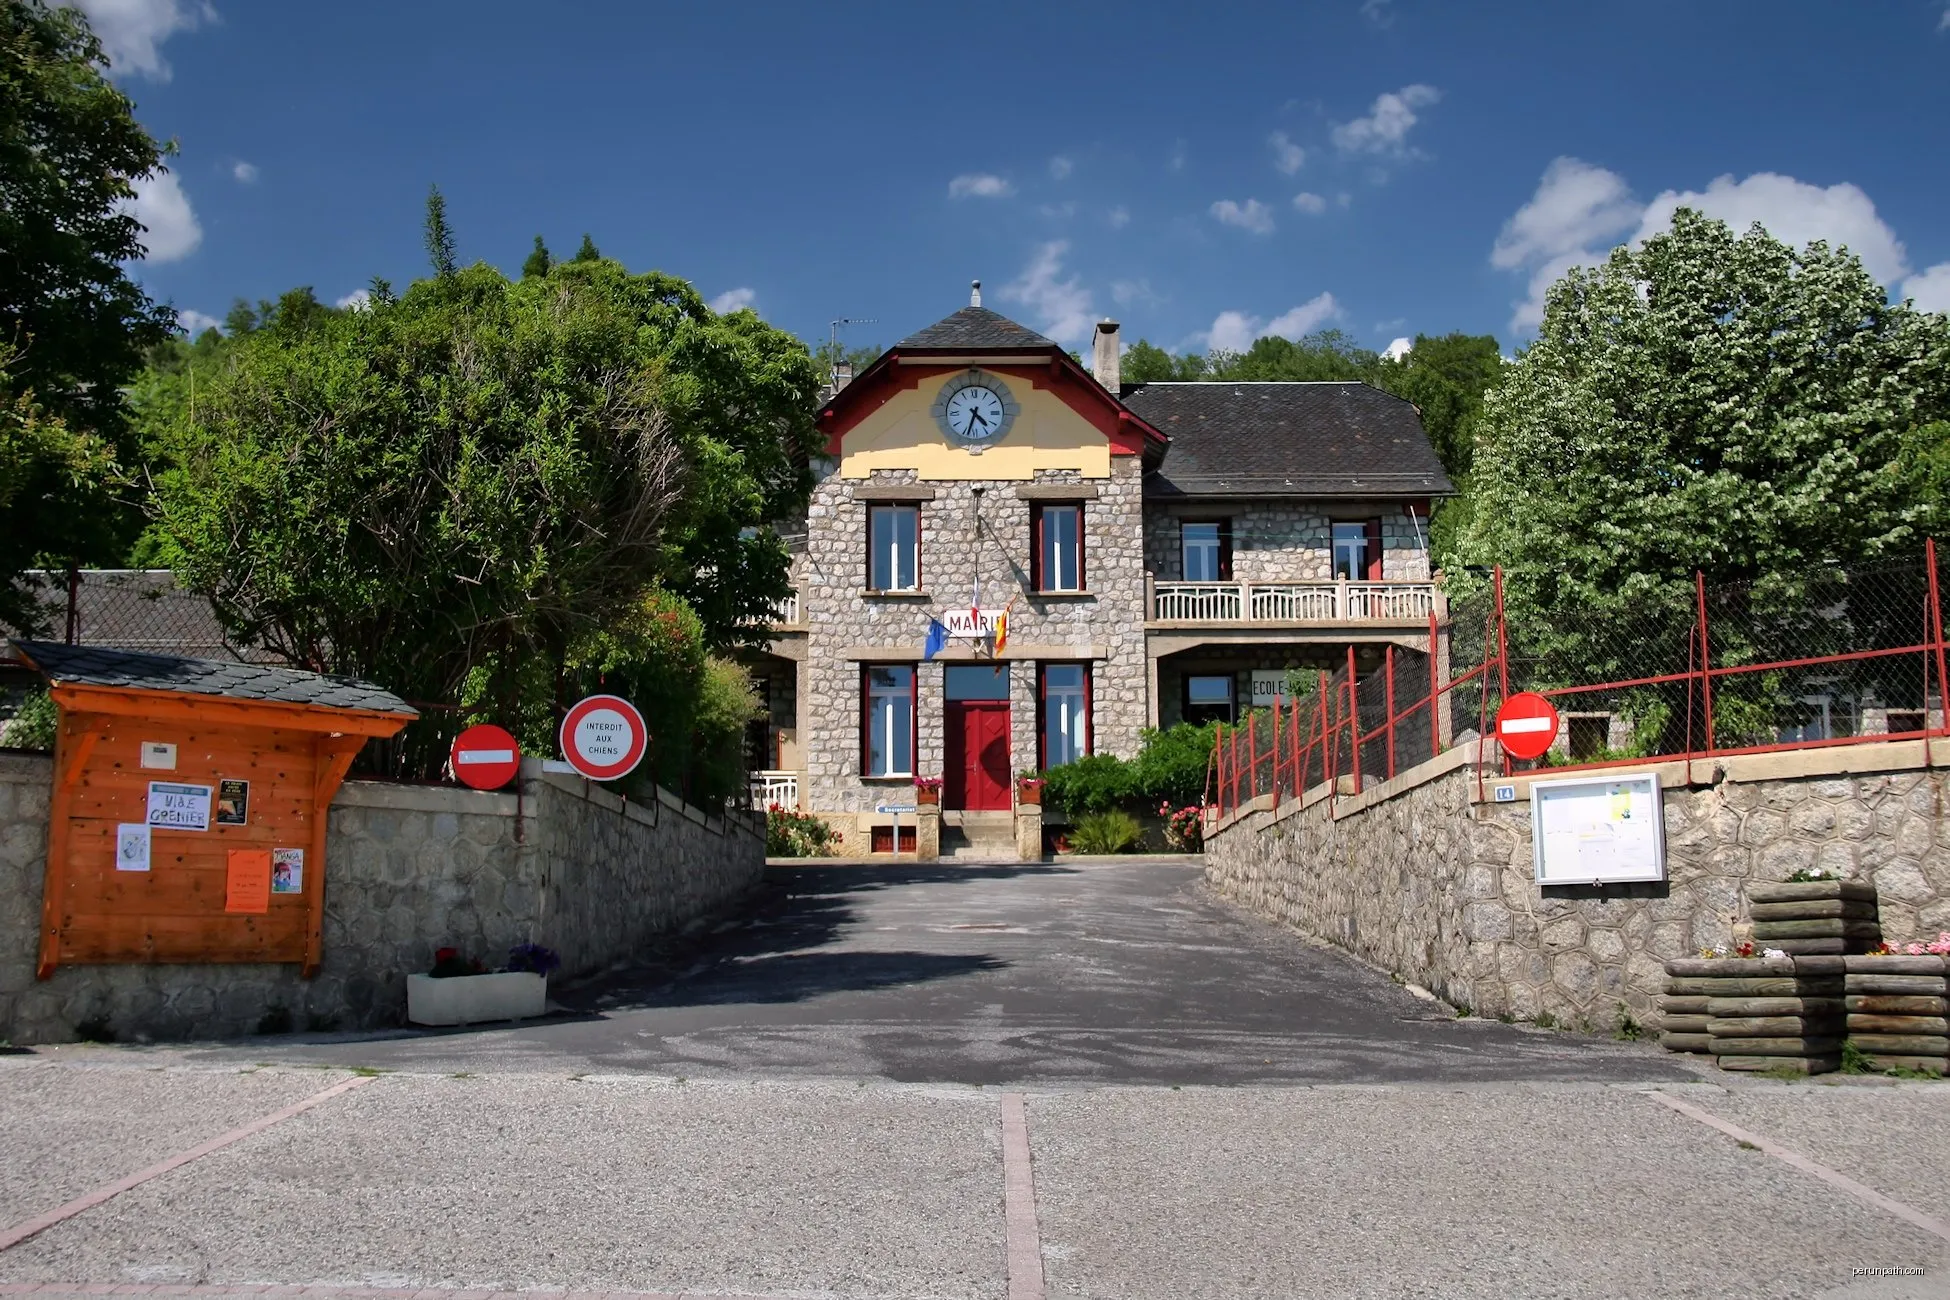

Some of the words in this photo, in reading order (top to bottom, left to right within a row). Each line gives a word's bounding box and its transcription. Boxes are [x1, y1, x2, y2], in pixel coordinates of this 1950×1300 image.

[586, 723, 622, 731] INTERDIT
[588, 746, 618, 754] CHIENS
[1499, 789, 1510, 798] 14
[150, 808, 204, 824] GRENIER
